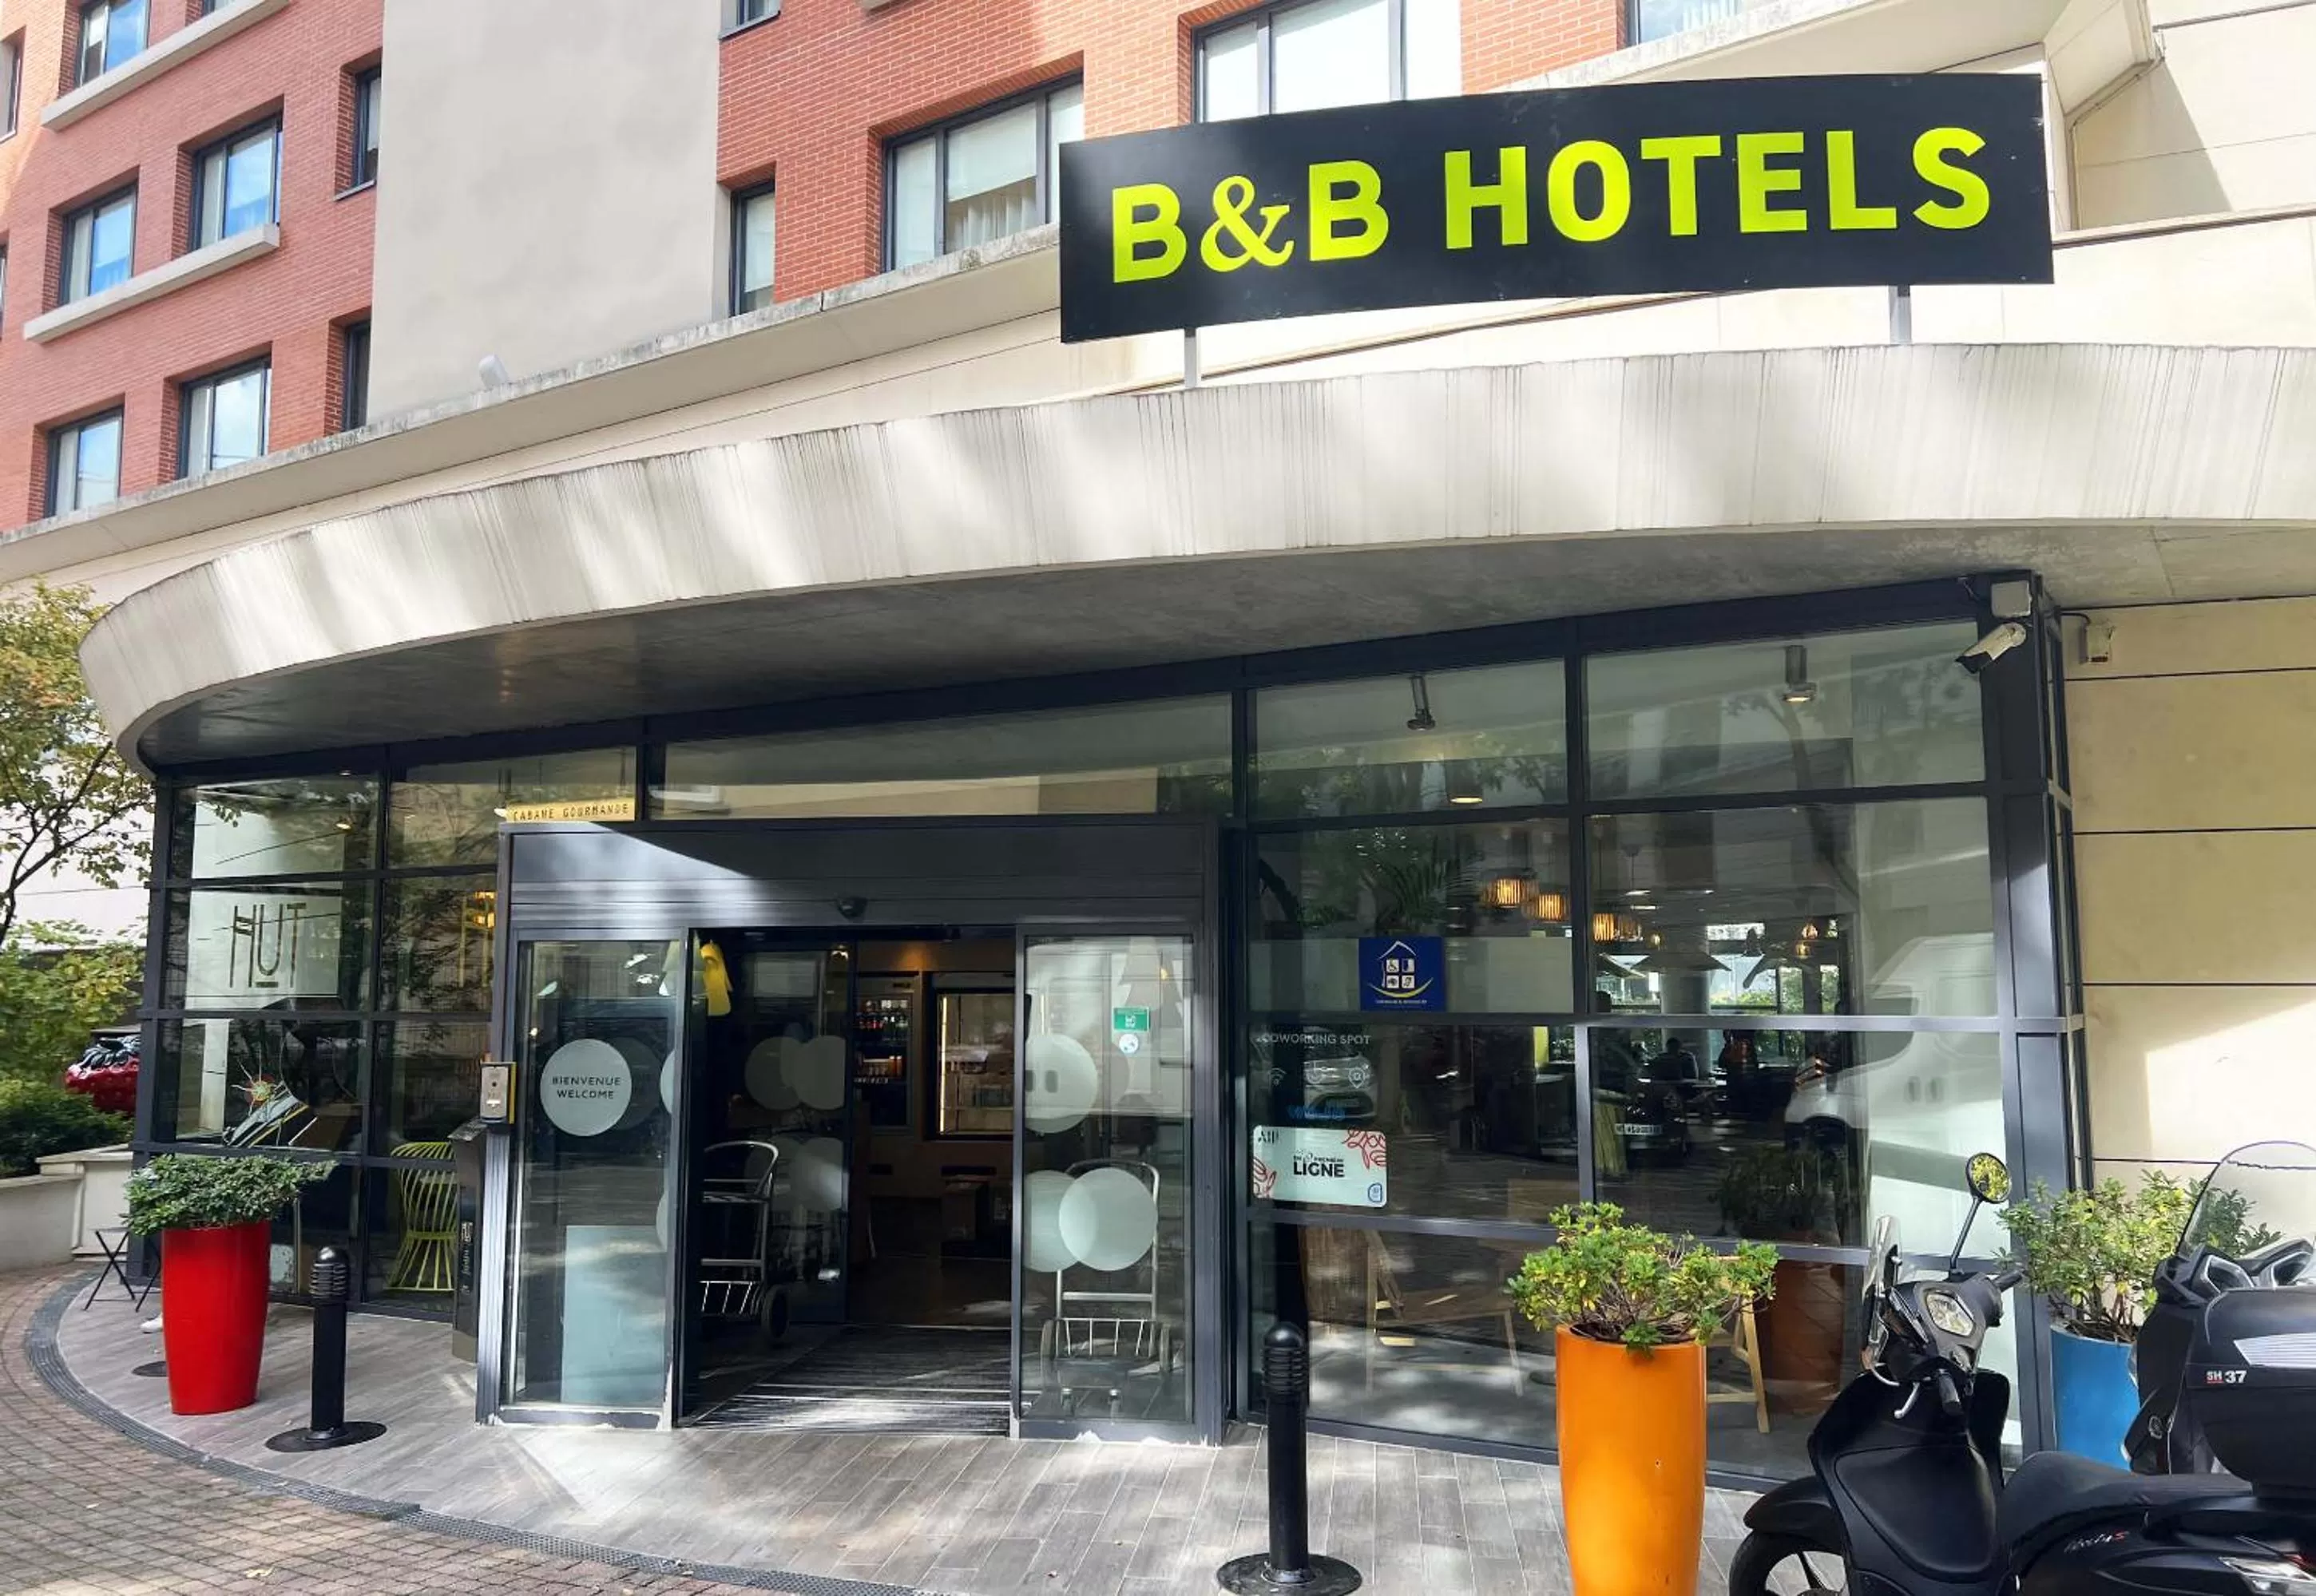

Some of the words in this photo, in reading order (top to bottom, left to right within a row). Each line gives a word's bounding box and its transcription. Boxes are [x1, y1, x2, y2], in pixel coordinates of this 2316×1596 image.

[1112, 160, 1390, 283] B&B
[1444, 126, 1991, 250] HOTELS
[514, 809, 554, 822] CABANE
[563, 803, 629, 818] GOURMANDE
[229, 902, 307, 988] HUT
[1340, 1035, 1372, 1045] SPOT
[552, 1075, 621, 1086] BIENVENUE
[557, 1089, 614, 1099] WELCOME
[1293, 1162, 1345, 1178] LIGNE
[2224, 1369, 2247, 1384] 37
